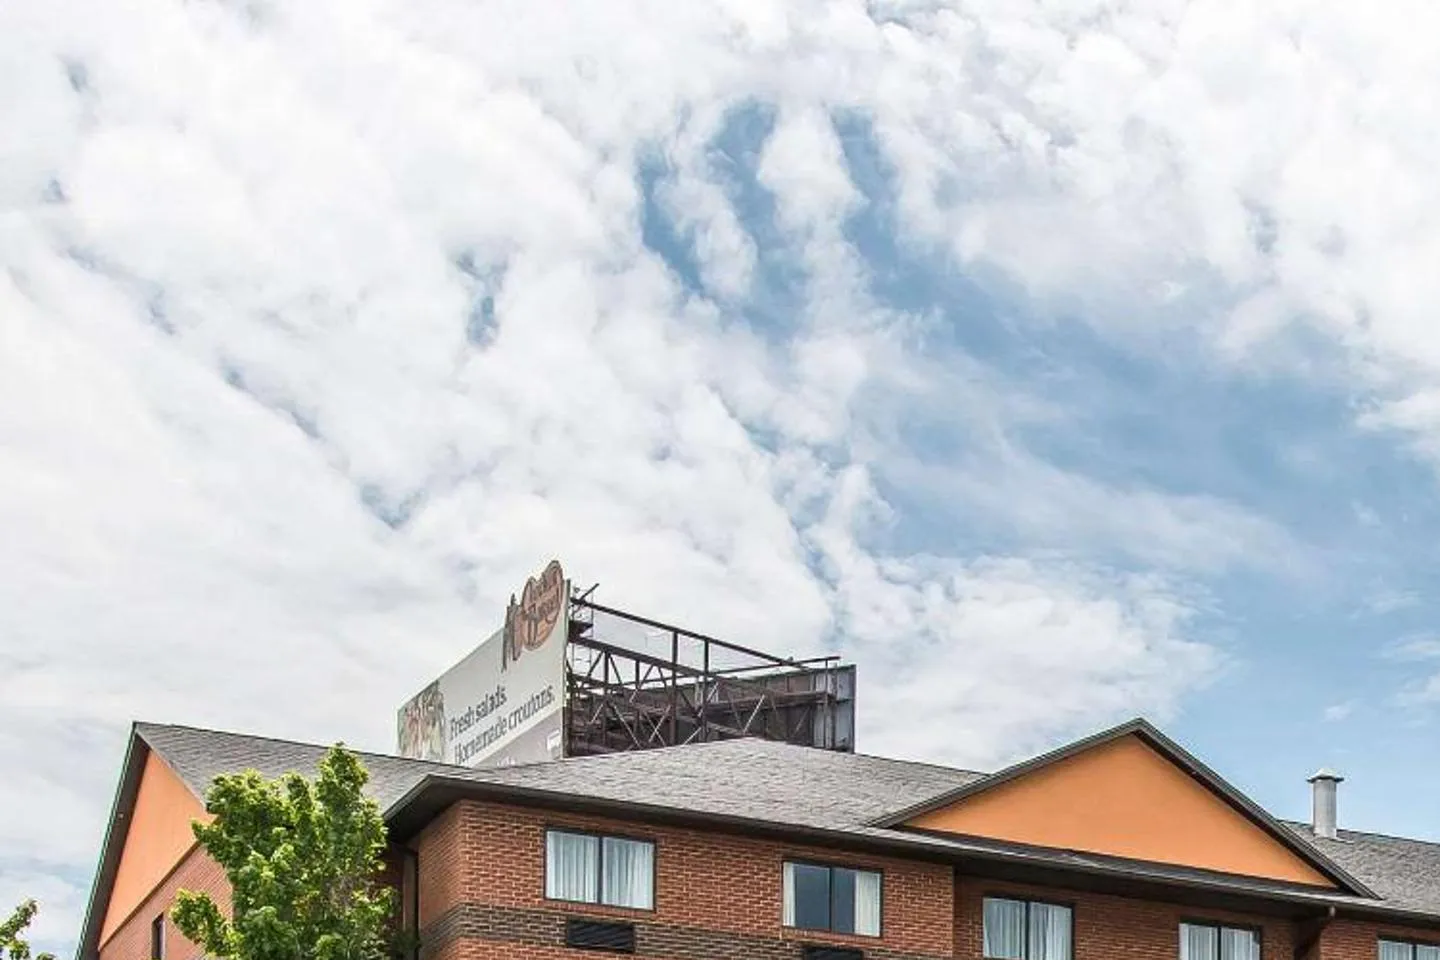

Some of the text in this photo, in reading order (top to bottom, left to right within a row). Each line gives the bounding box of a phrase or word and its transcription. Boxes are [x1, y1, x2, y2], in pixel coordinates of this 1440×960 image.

[450, 684, 507, 740] Fresh salads
[454, 716, 507, 764] Homemade
